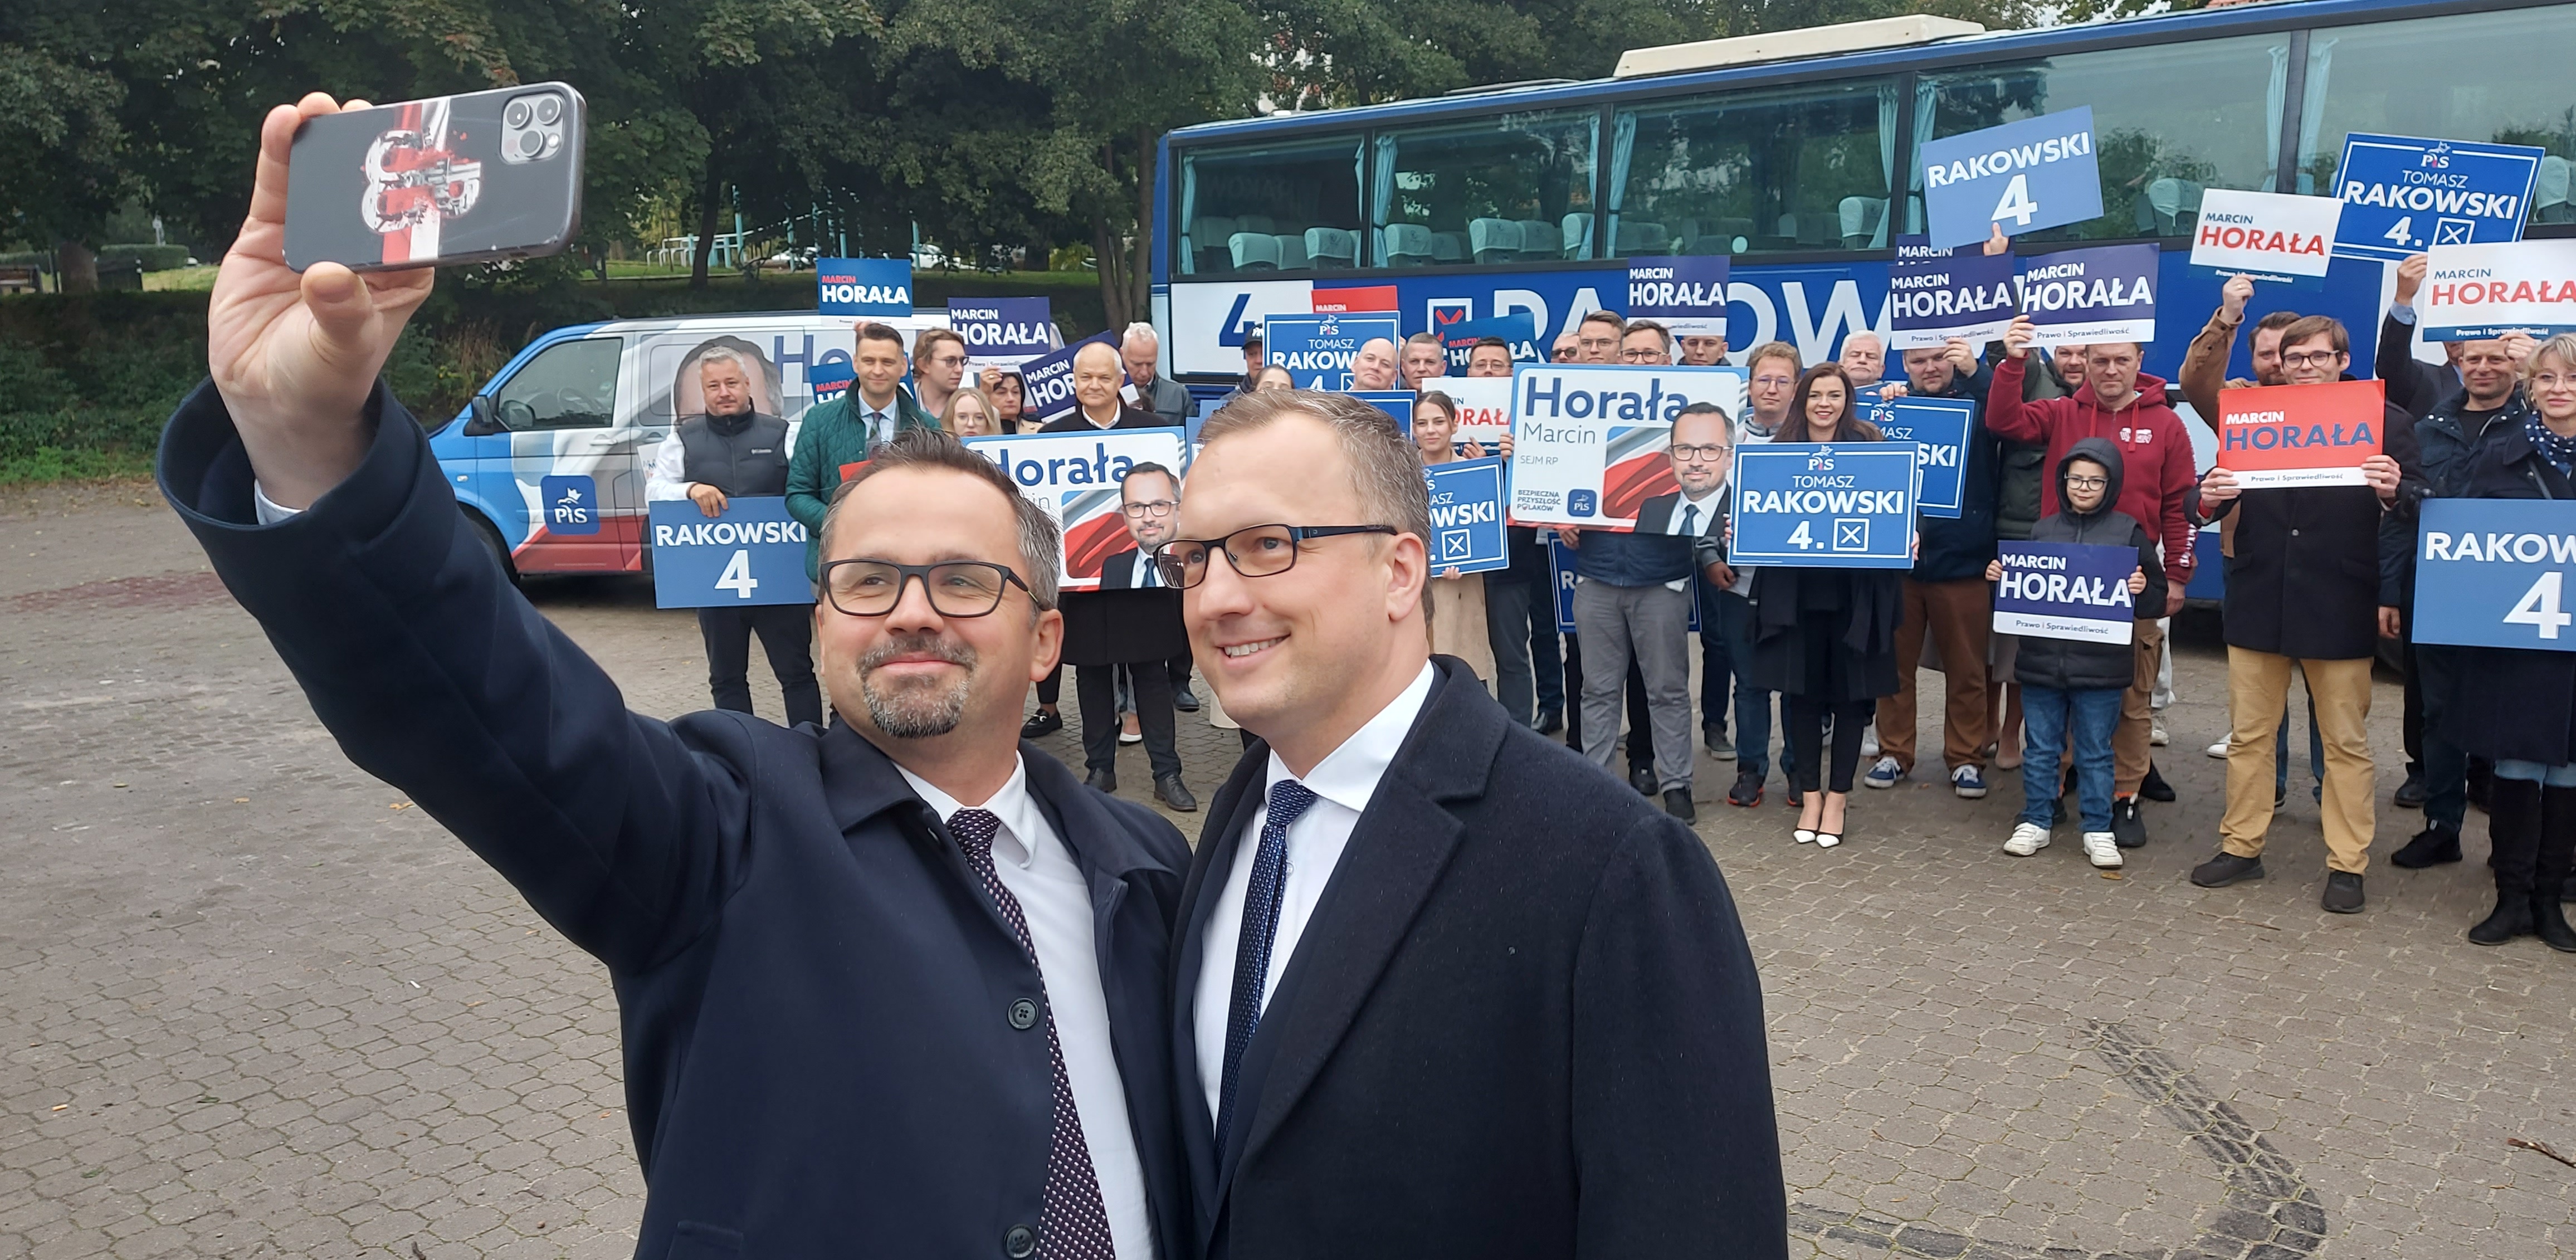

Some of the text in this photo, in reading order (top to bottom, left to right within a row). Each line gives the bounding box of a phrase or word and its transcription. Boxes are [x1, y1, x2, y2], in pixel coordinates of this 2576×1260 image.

[1928, 131, 2090, 188] RAKOWSKI
[2402, 170, 2468, 188] TOMASZ
[1991, 174, 2038, 226] 4
[2344, 180, 2518, 219] RAKOWSKI
[2205, 212, 2253, 224] MARCIN
[2200, 226, 2325, 256] HORAŁA
[2384, 216, 2422, 246] 4.
[821, 275, 856, 284] MARCIN
[1629, 267, 1674, 280] MARCIN
[1891, 273, 1949, 289] MARCIN
[2026, 262, 2085, 282] MARCIN
[2434, 268, 2491, 280] MARCIN
[822, 285, 909, 304] HORAŁA
[1629, 282, 1726, 306] HORAŁA
[1892, 282, 2012, 318] HORAŁA
[2021, 276, 2154, 313] HORAŁA
[2432, 280, 2576, 306] HORAŁA
[951, 309, 998, 320] MARCIN
[952, 322, 1049, 345] HORAŁA
[1307, 339, 1354, 350] TOMASZ
[1026, 359, 1070, 383] MARCIN
[1272, 351, 1359, 370] RAKOW
[1031, 373, 1077, 407] HOR
[1525, 377, 1688, 422] Horała
[2225, 411, 2285, 424] MARCIN
[1523, 422, 1596, 445] Marcin
[2225, 422, 2375, 451] HORAŁA
[1520, 455, 1559, 465] SEJM RP
[1792, 476, 1855, 488] TOMASZ
[1743, 490, 1904, 514] RAKOWSKI
[655, 521, 807, 546] RAKOWSKI
[1787, 520, 1825, 550] 4.
[2425, 531, 2576, 564] RAKOW
[714, 549, 758, 599] 4
[2002, 554, 2067, 570] MARCIN
[1999, 570, 2133, 608] HORAŁA
[2502, 571, 2572, 639] 4
[2016, 620, 2040, 628] Prawo
